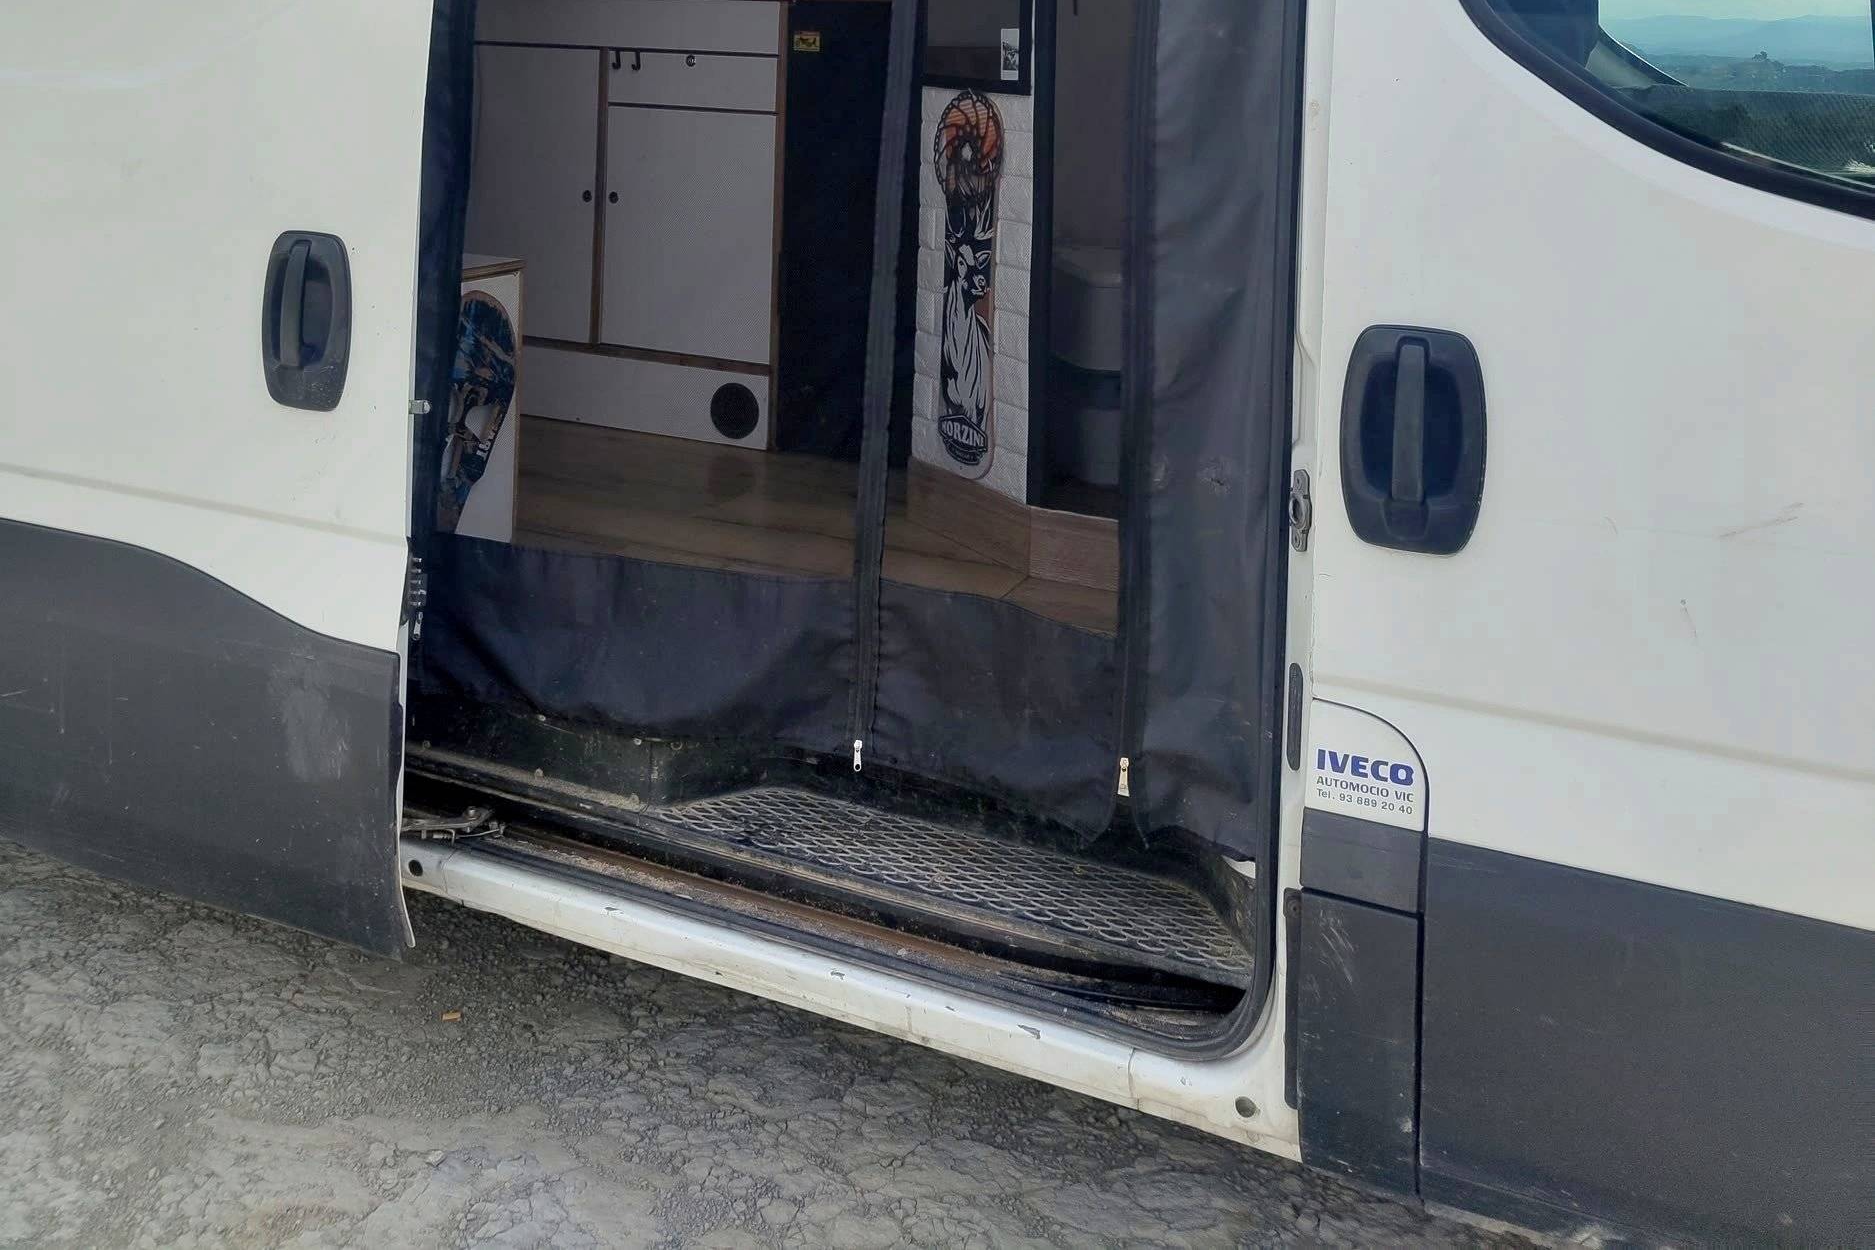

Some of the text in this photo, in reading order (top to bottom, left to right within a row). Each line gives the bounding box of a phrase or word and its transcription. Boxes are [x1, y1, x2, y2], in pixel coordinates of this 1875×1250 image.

[1317, 748, 1414, 786] IVECO
[1316, 788, 1413, 815] Tel. 93 889 20 40
[1394, 790, 1414, 803] VIC
